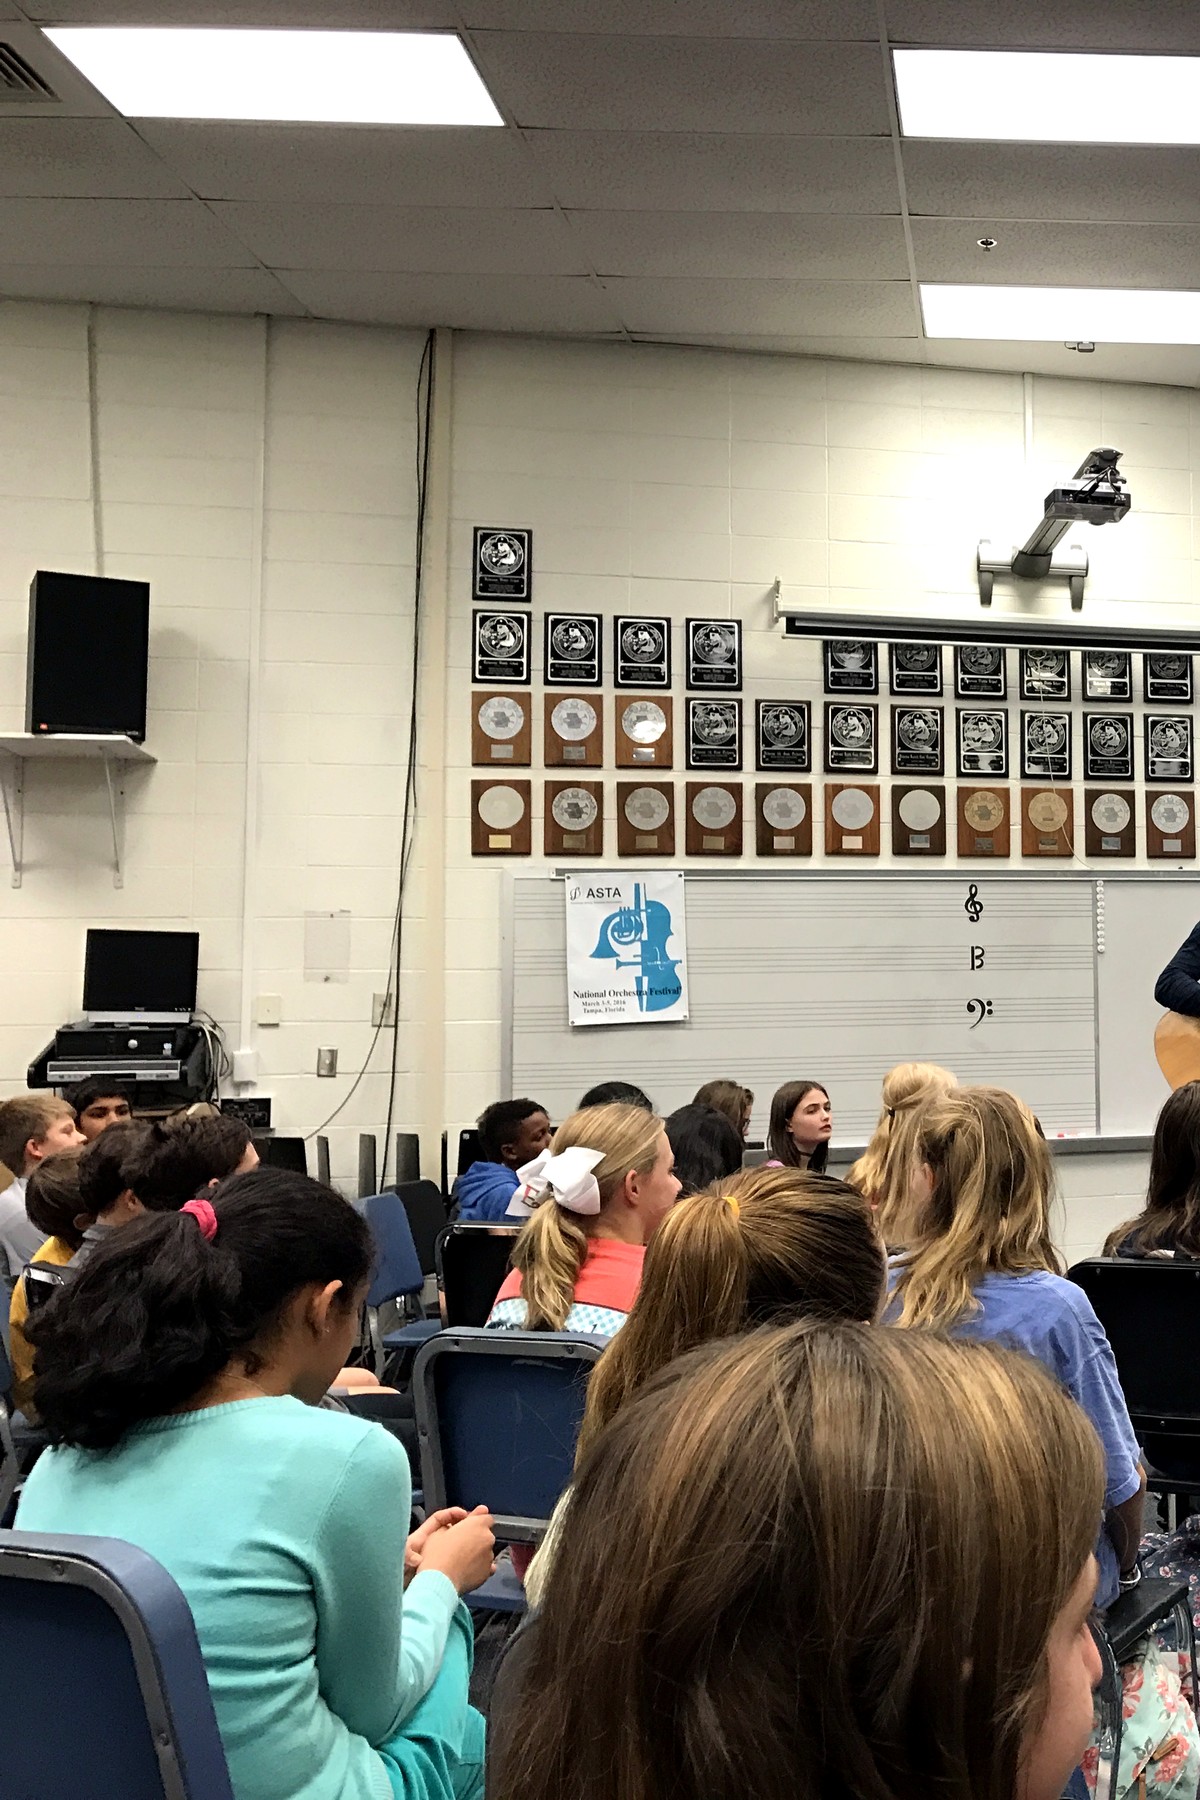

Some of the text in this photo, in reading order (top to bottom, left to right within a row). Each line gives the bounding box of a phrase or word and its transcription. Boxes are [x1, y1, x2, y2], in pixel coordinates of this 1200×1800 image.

[587, 887, 621, 898] ASTA
[573, 991, 607, 999] National
[608, 988, 648, 997] Orchestra
